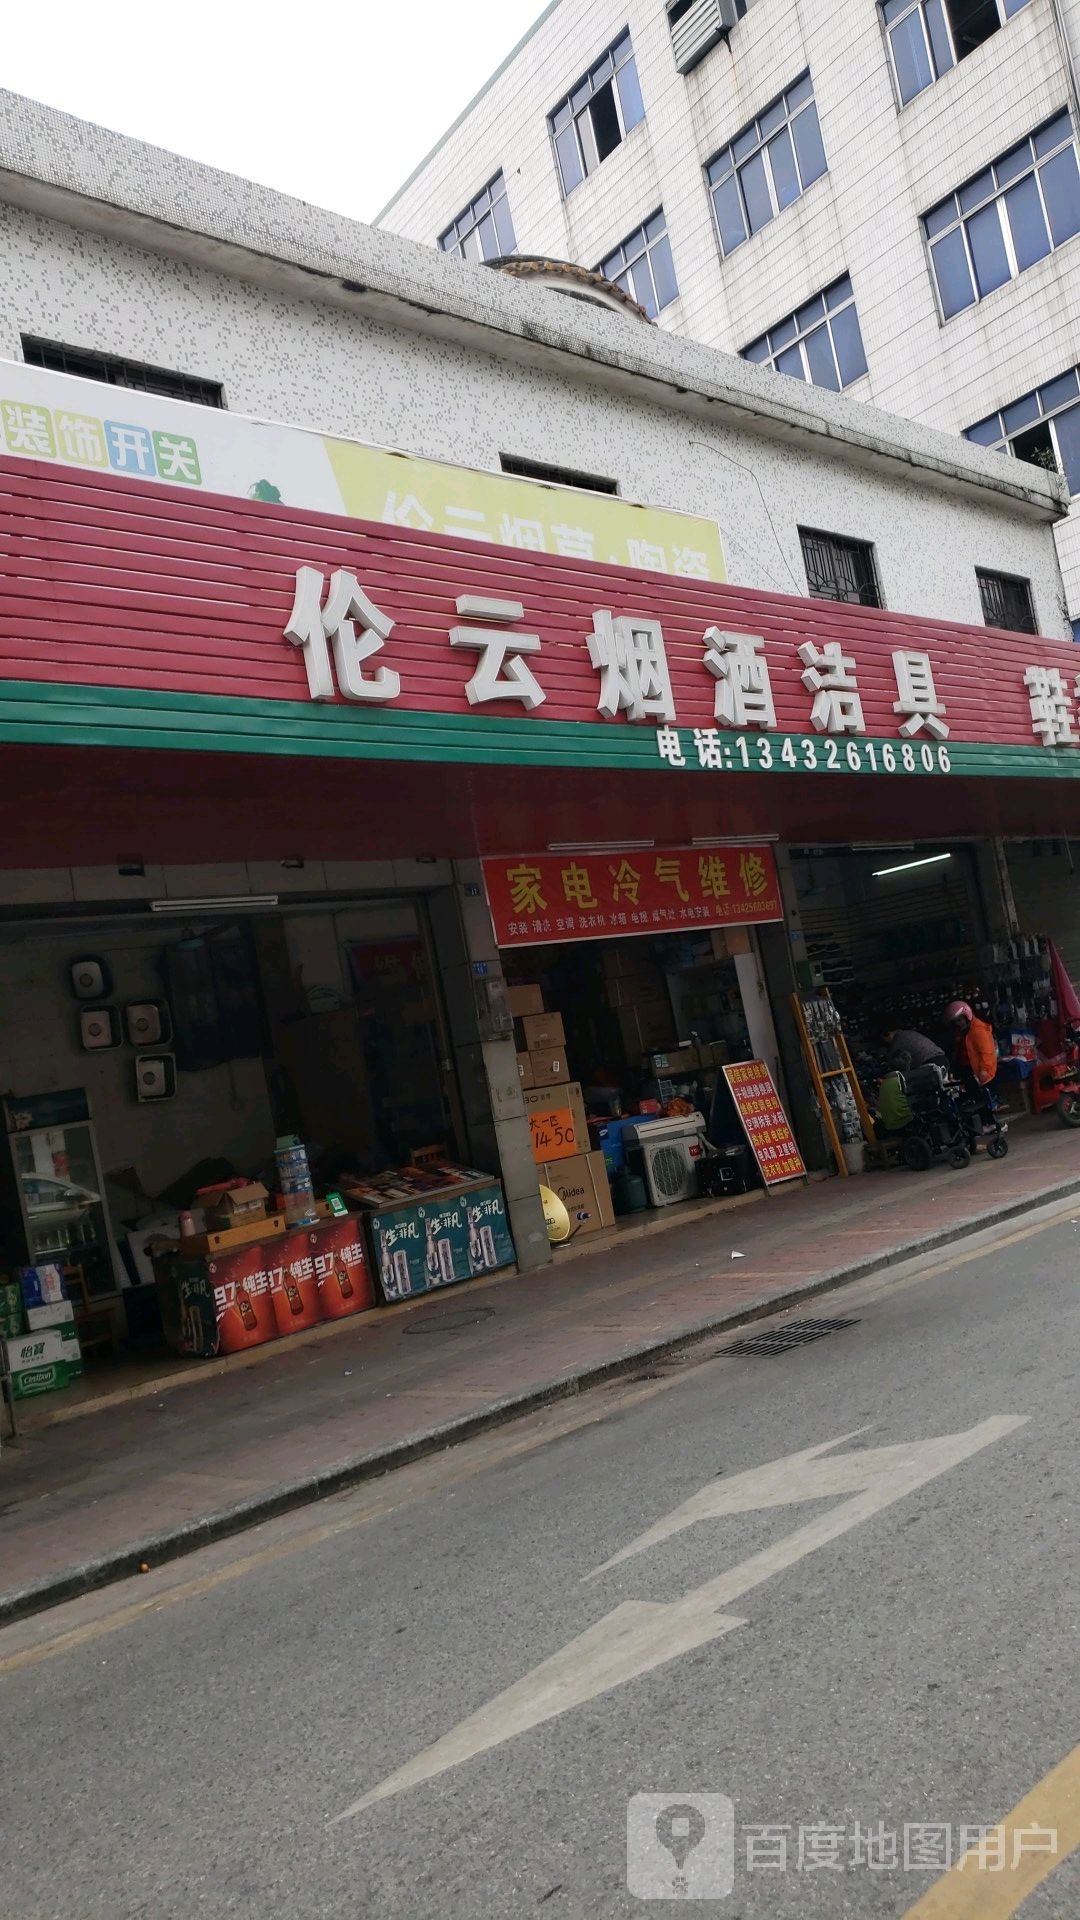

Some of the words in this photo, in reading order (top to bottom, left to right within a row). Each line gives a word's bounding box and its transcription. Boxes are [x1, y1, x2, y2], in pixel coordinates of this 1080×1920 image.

[4, 404, 198, 481] 装饰开关
[283, 565, 951, 741] 伦云烟酒洁具
[1022, 664, 1080, 747] 鞋
[656, 724, 951, 774] 电话:13432616806
[506, 852, 769, 914] 家电冷气维修
[507, 921, 529, 936] 安装
[532, 918, 552, 933] 清洗
[556, 916, 575, 931] 空调
[578, 913, 606, 928] 洗衣机
[609, 912, 627, 926] 冰箱
[631, 910, 648, 924] 电视
[680, 905, 711, 919] 水电安装
[535, 1127, 575, 1149] 1450
[557, 1186, 585, 1201] Midea
